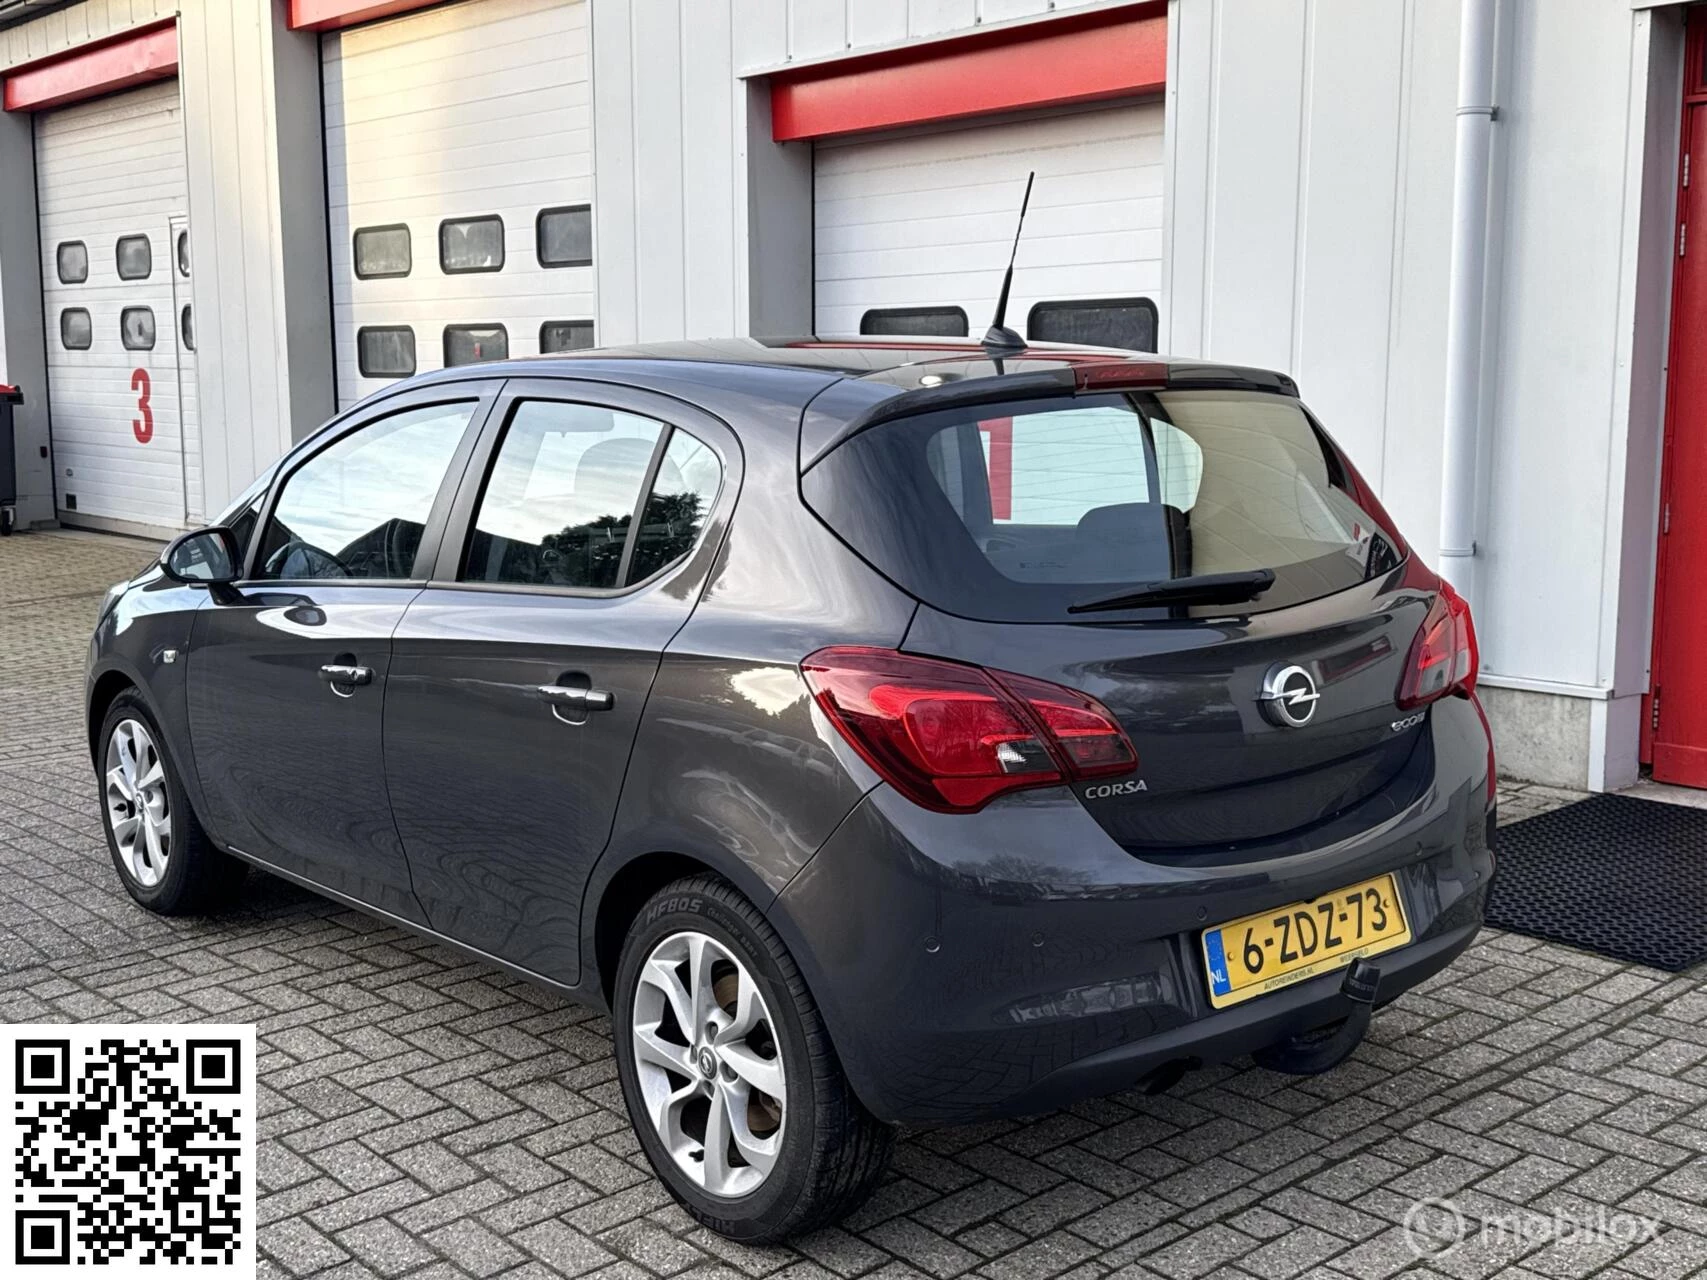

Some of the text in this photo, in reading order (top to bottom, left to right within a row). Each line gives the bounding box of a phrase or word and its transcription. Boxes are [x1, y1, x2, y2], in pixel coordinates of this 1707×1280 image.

[131, 368, 154, 443] 3
[1085, 779, 1148, 799] CORSA
[1243, 888, 1387, 974] 6-ZDZ-73
[1211, 969, 1227, 985] NL
